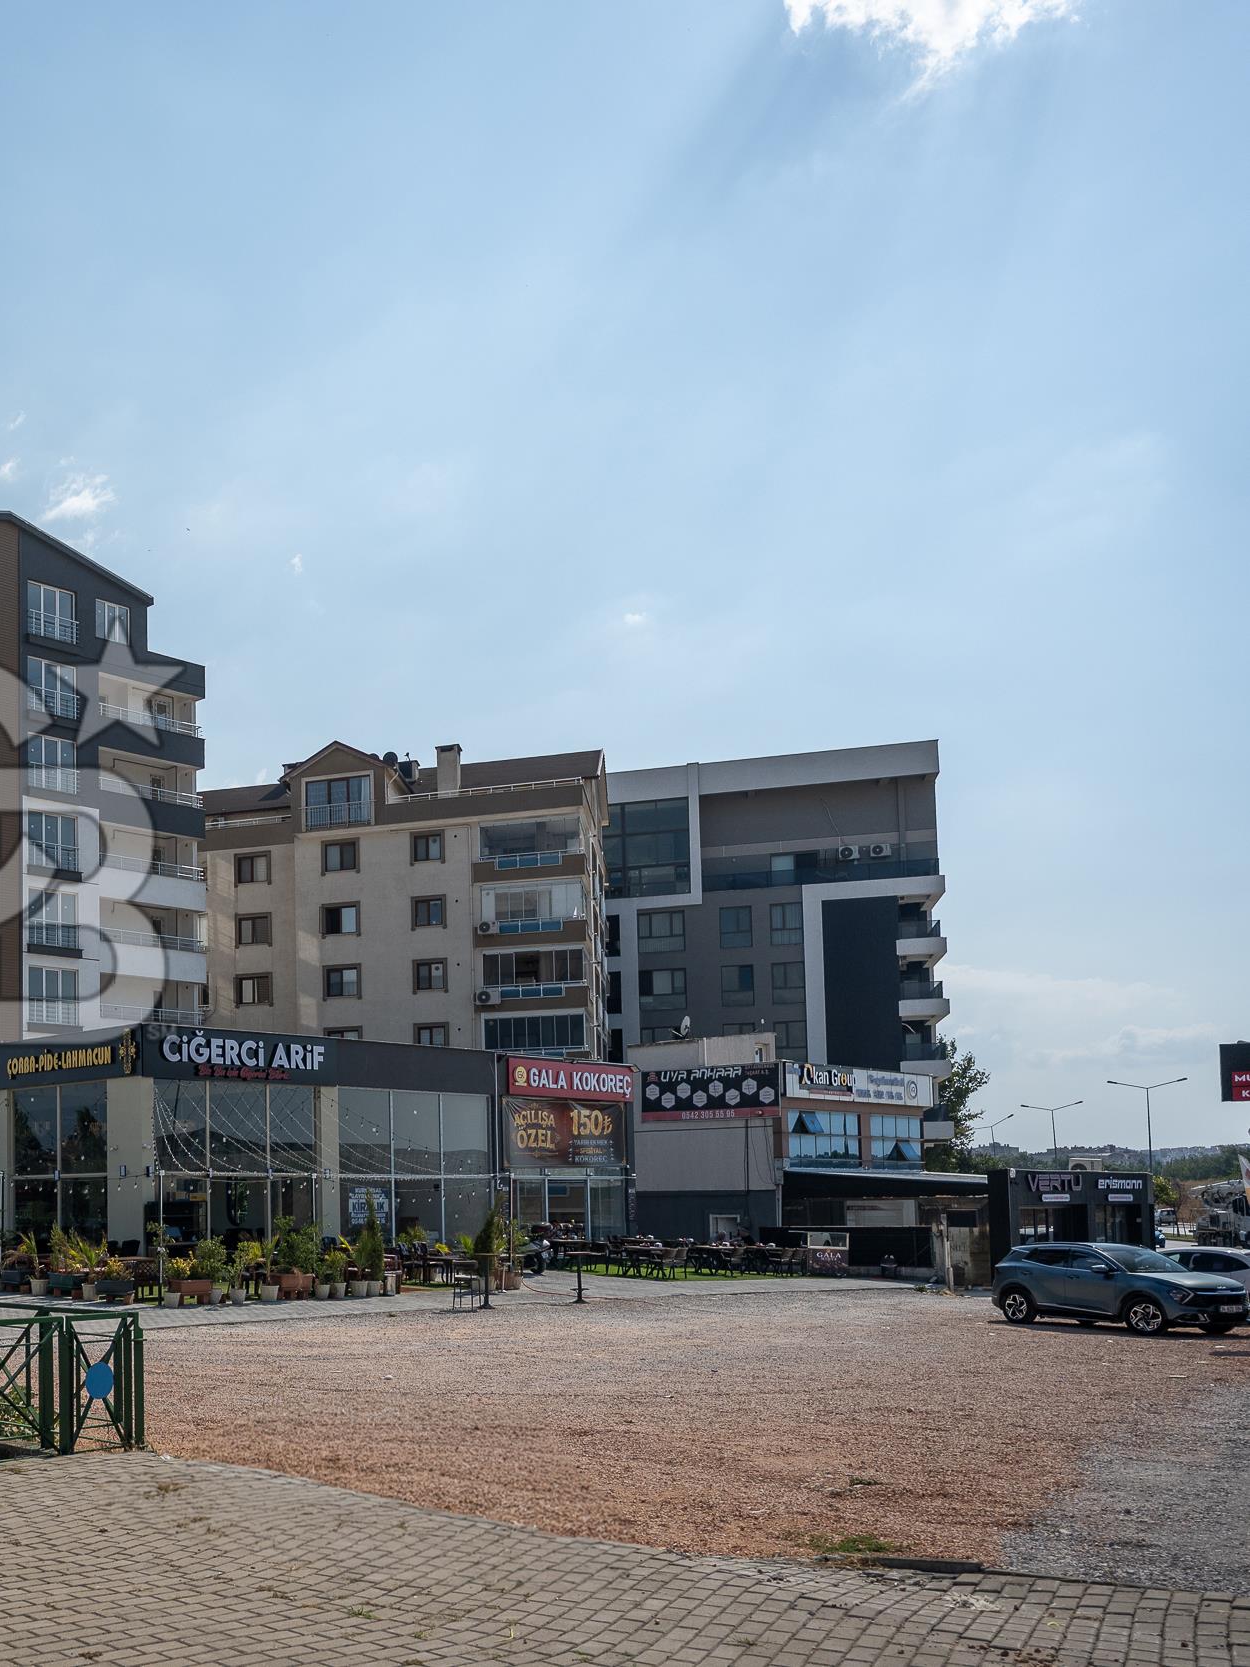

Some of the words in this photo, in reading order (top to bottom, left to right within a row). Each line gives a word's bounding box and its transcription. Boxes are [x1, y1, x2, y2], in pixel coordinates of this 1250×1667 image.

[530, 1067, 567, 1090] GALA
[573, 1071, 632, 1098] KOKOREÇ
[514, 1109, 556, 1128] AÇILIŞA
[517, 1126, 556, 1150] ÖZEL
[1027, 1174, 1082, 1192] VERTU
[1097, 1177, 1143, 1190] erismann
